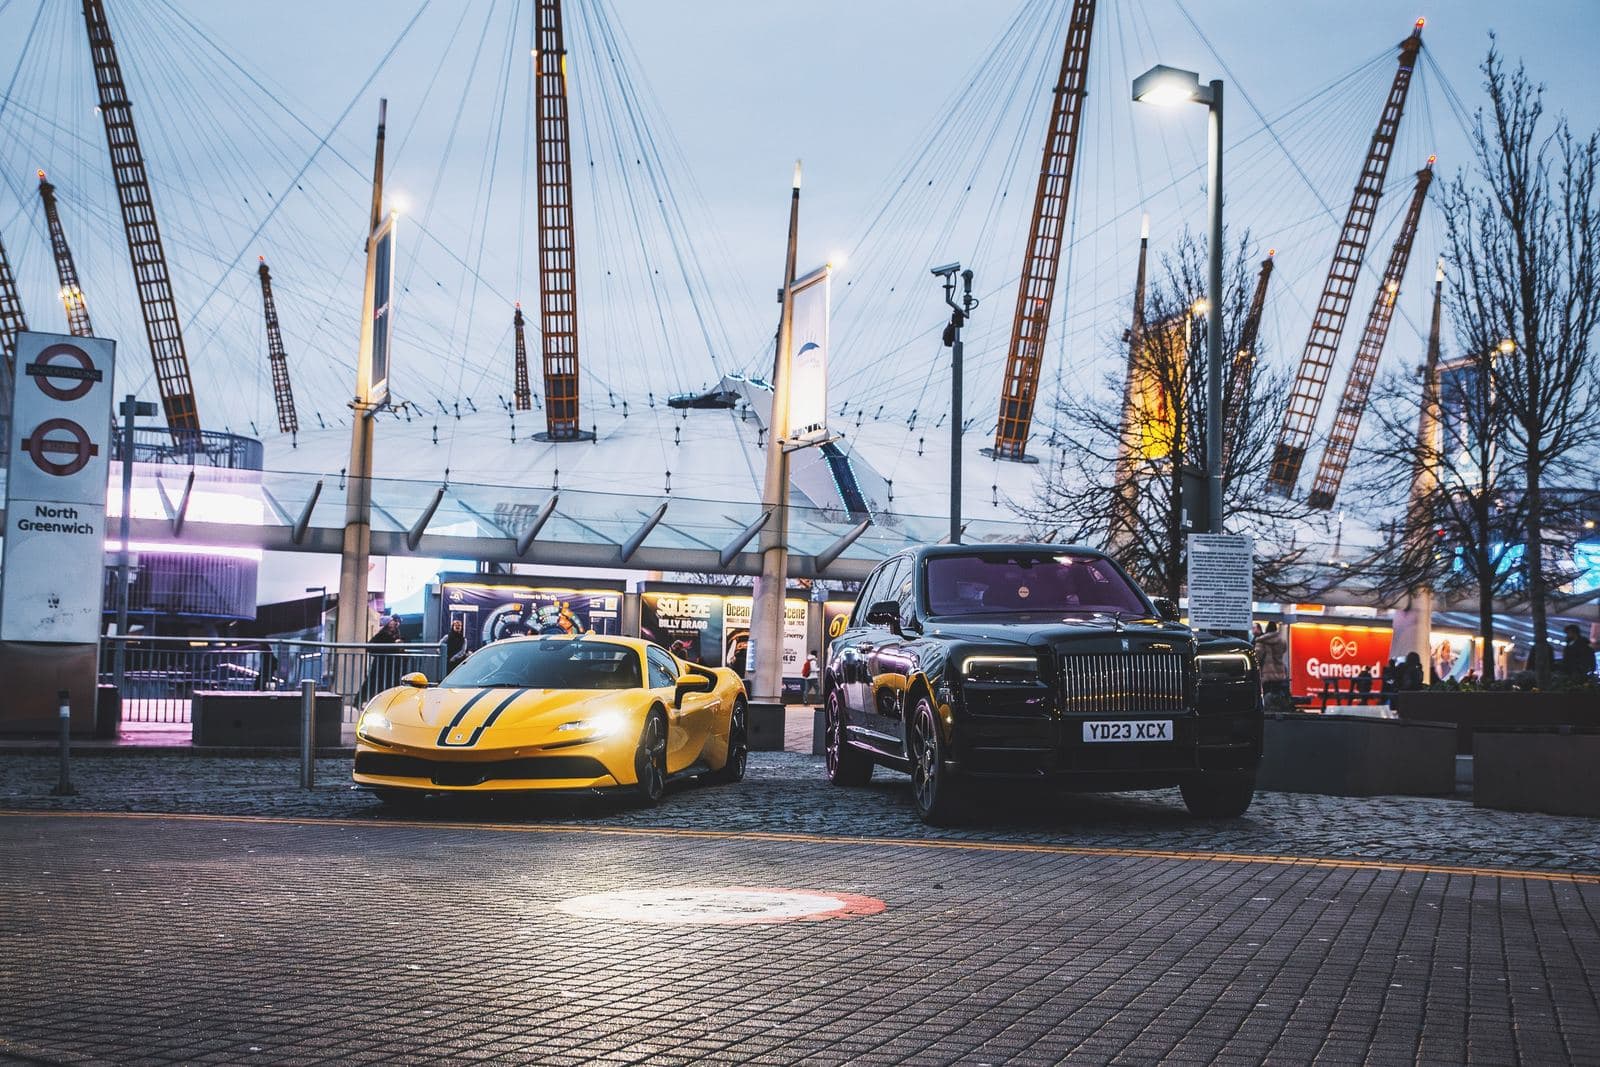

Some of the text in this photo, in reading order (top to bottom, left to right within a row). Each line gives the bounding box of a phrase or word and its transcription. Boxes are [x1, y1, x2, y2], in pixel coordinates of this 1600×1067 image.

[35, 505, 78, 519] North
[17, 519, 93, 534] Greenwich
[656, 598, 711, 618] SQUEEZE
[726, 603, 750, 617] Ocean
[658, 619, 708, 630] BILLY BRAGG
[1306, 657, 1380, 679] Gamepd
[1090, 723, 1166, 739] YD23 XCX
